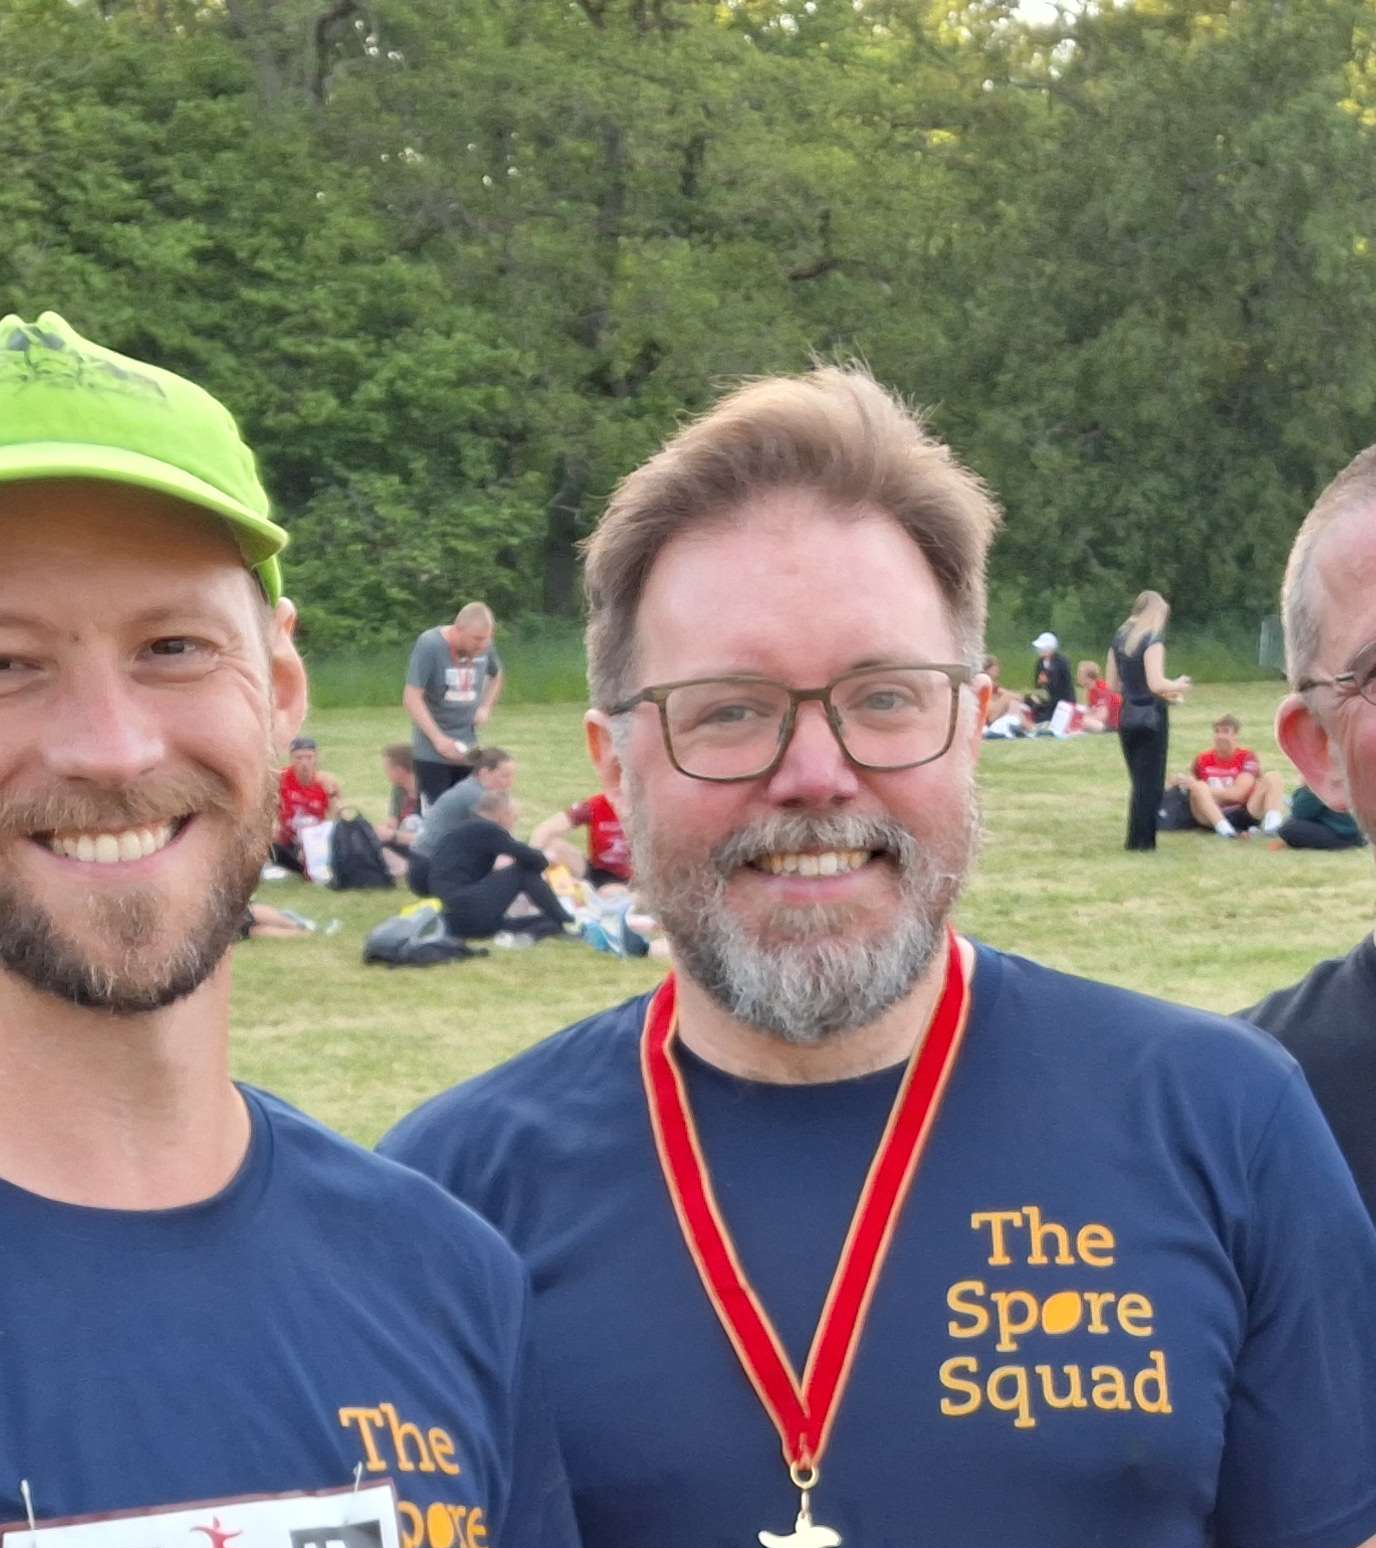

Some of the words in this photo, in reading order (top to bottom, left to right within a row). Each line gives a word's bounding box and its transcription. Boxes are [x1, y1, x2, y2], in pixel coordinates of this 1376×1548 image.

[971, 1206, 1116, 1267] The
[947, 1280, 1153, 1352] Spore
[939, 1350, 1173, 1428] Squad
[339, 1403, 460, 1475] The
